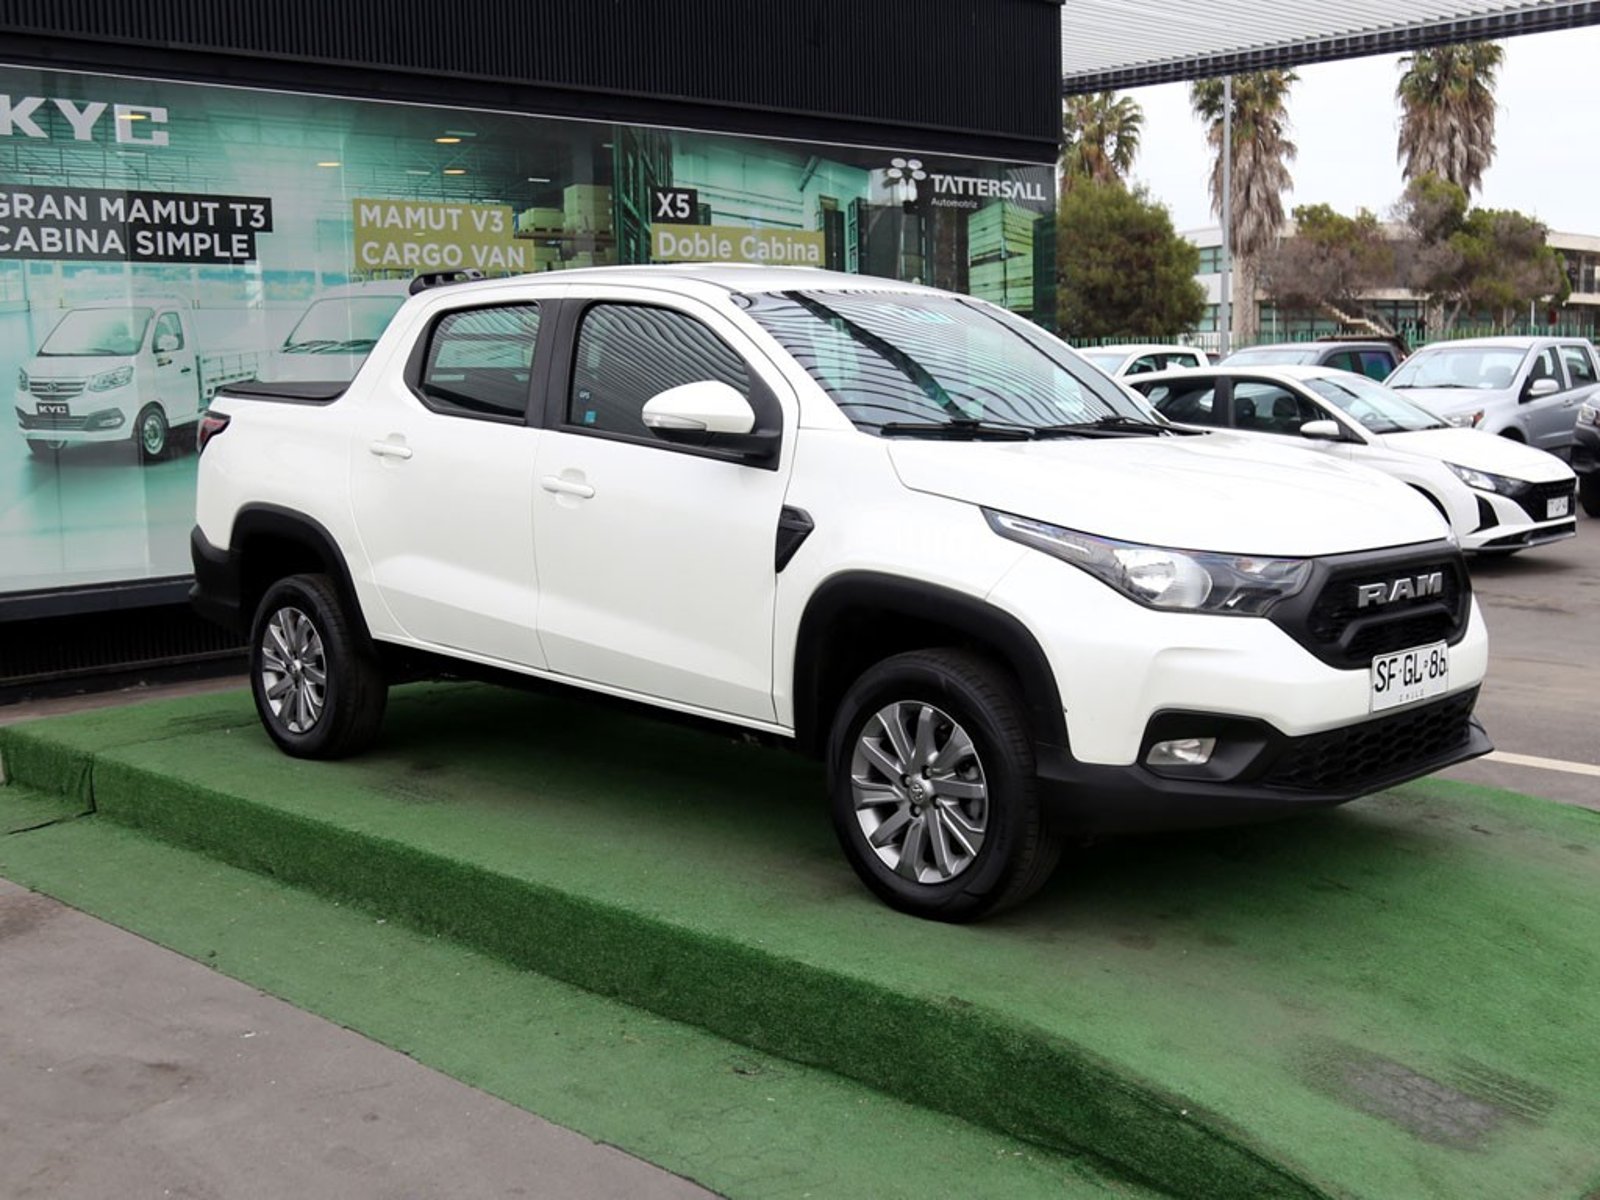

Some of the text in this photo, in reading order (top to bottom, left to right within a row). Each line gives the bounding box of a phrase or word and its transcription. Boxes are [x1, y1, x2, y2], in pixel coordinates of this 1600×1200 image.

[0, 94, 169, 146] KYC
[930, 174, 1046, 201] TATTERSALL
[99, 197, 220, 226] MAMUT
[229, 203, 266, 229] T3
[656, 192, 691, 219] X5
[930, 197, 978, 209] Automotriz
[360, 204, 505, 233] MAMUT V3
[135, 230, 250, 258] SIMPLE
[361, 241, 525, 268] CARGO VAN
[658, 231, 820, 262] Doble Cabina
[38, 405, 67, 414] KYC
[1358, 572, 1443, 609] RAM
